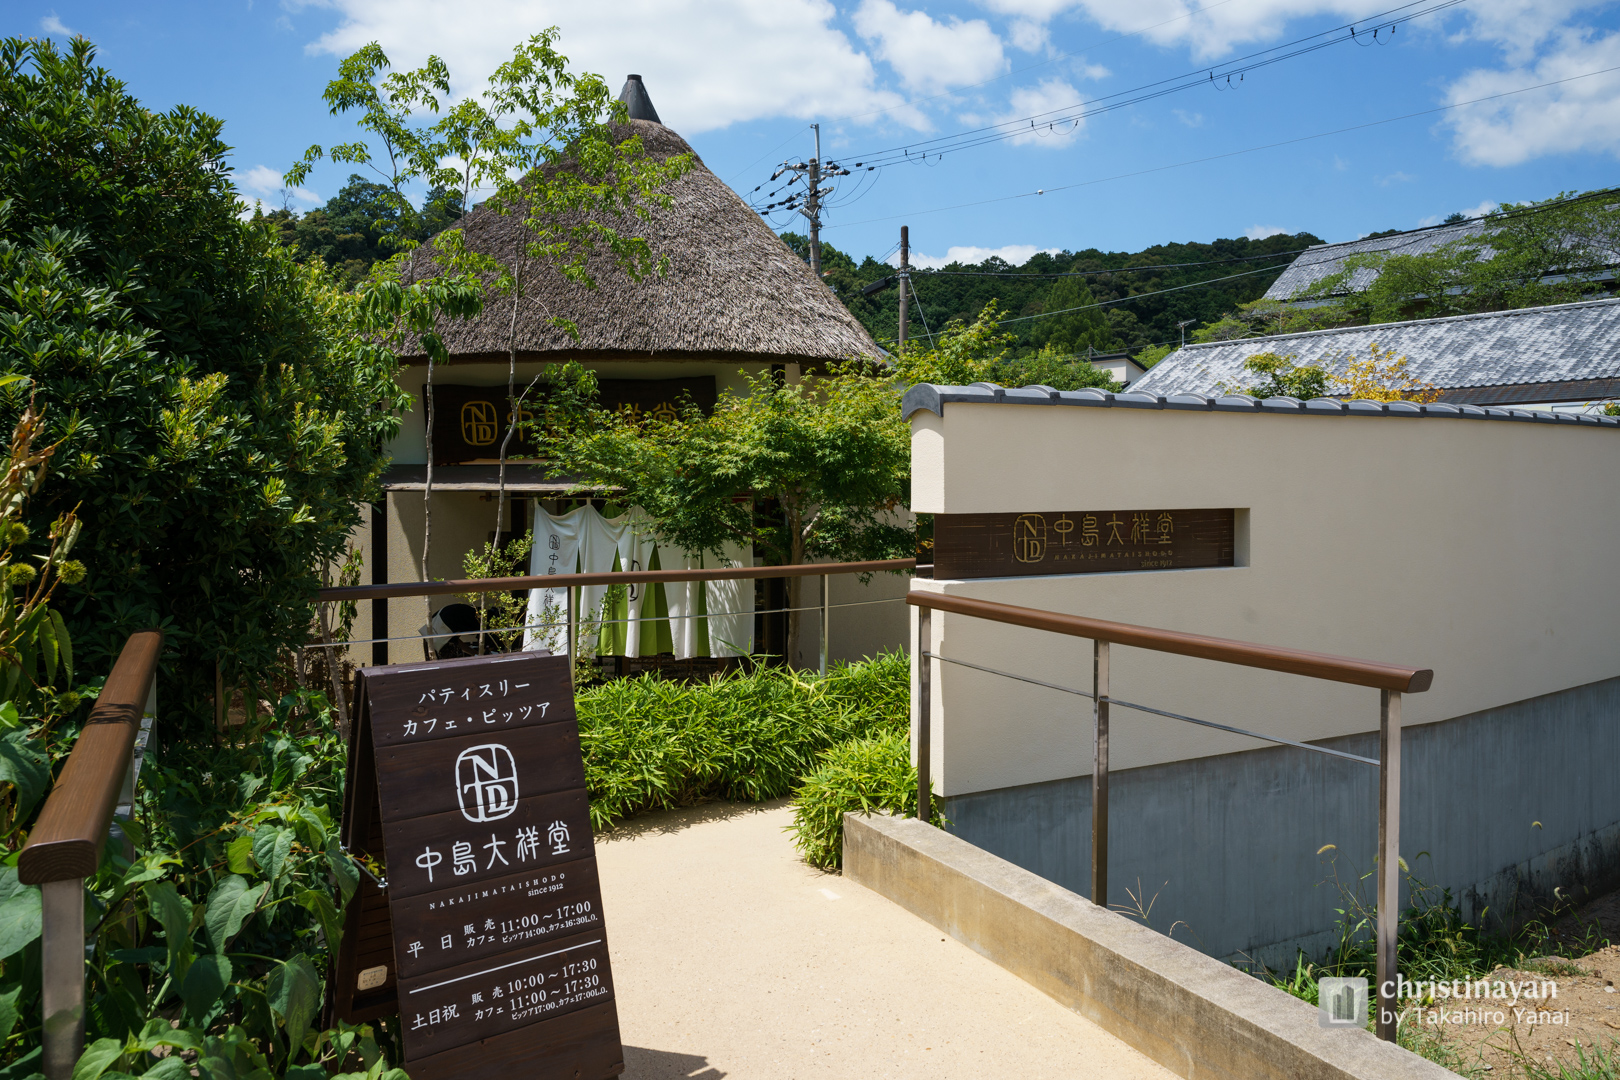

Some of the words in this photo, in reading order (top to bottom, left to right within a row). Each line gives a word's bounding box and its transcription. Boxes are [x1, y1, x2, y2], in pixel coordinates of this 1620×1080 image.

[1053, 512, 1174, 547] 中島大祥堂
[1140, 560, 1158, 568] since
[419, 679, 530, 704] パティスリー
[403, 701, 550, 737] カフェ・ピッツア
[415, 820, 570, 883] 中島大祥堂
[429, 873, 565, 910] NAKAJIMATAISHODO
[528, 886, 547, 897] since
[549, 883, 564, 893] 1912
[466, 935, 496, 949] カフェ
[411, 1004, 460, 1031] 土日祝
[475, 1007, 504, 1021] カフェ
